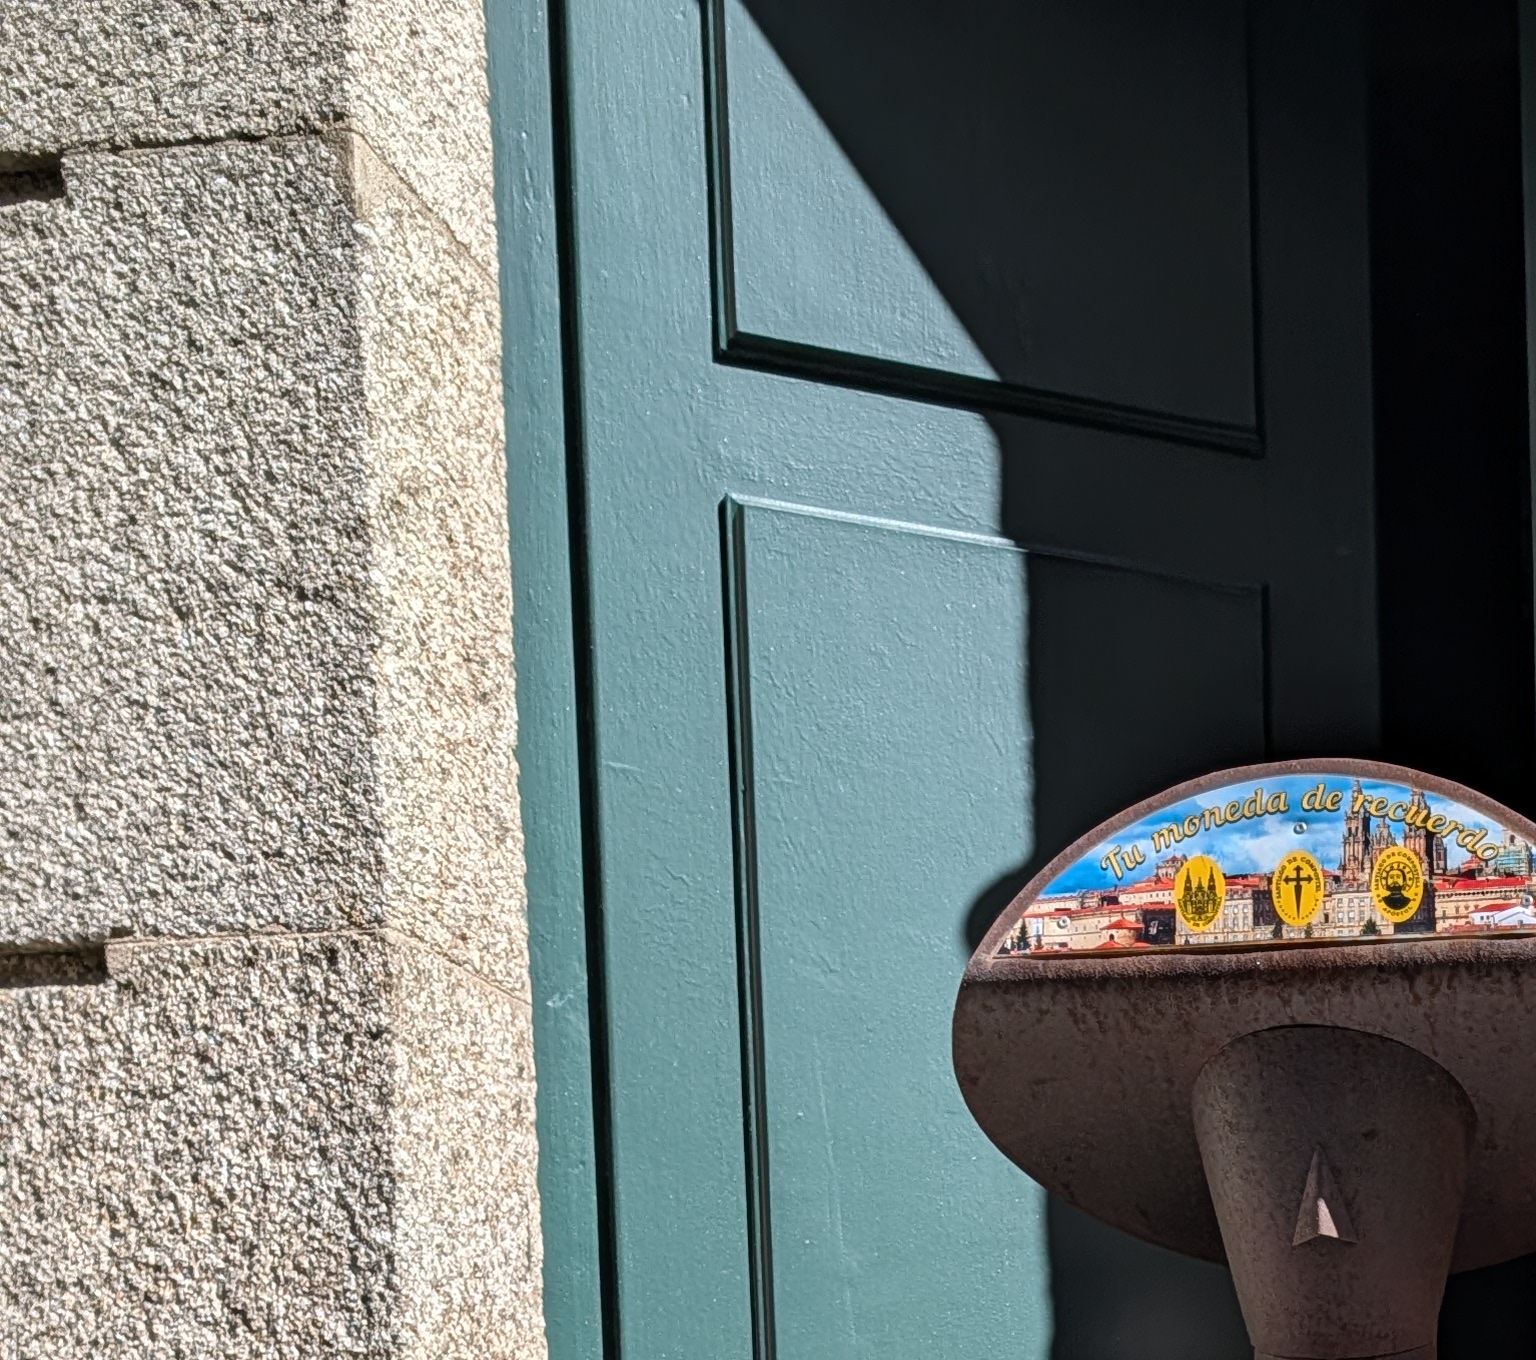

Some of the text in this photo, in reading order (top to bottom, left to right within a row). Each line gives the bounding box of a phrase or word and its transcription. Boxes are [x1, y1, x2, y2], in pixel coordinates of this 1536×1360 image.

[1101, 783, 1500, 880] Tu moneda de recuerdo
